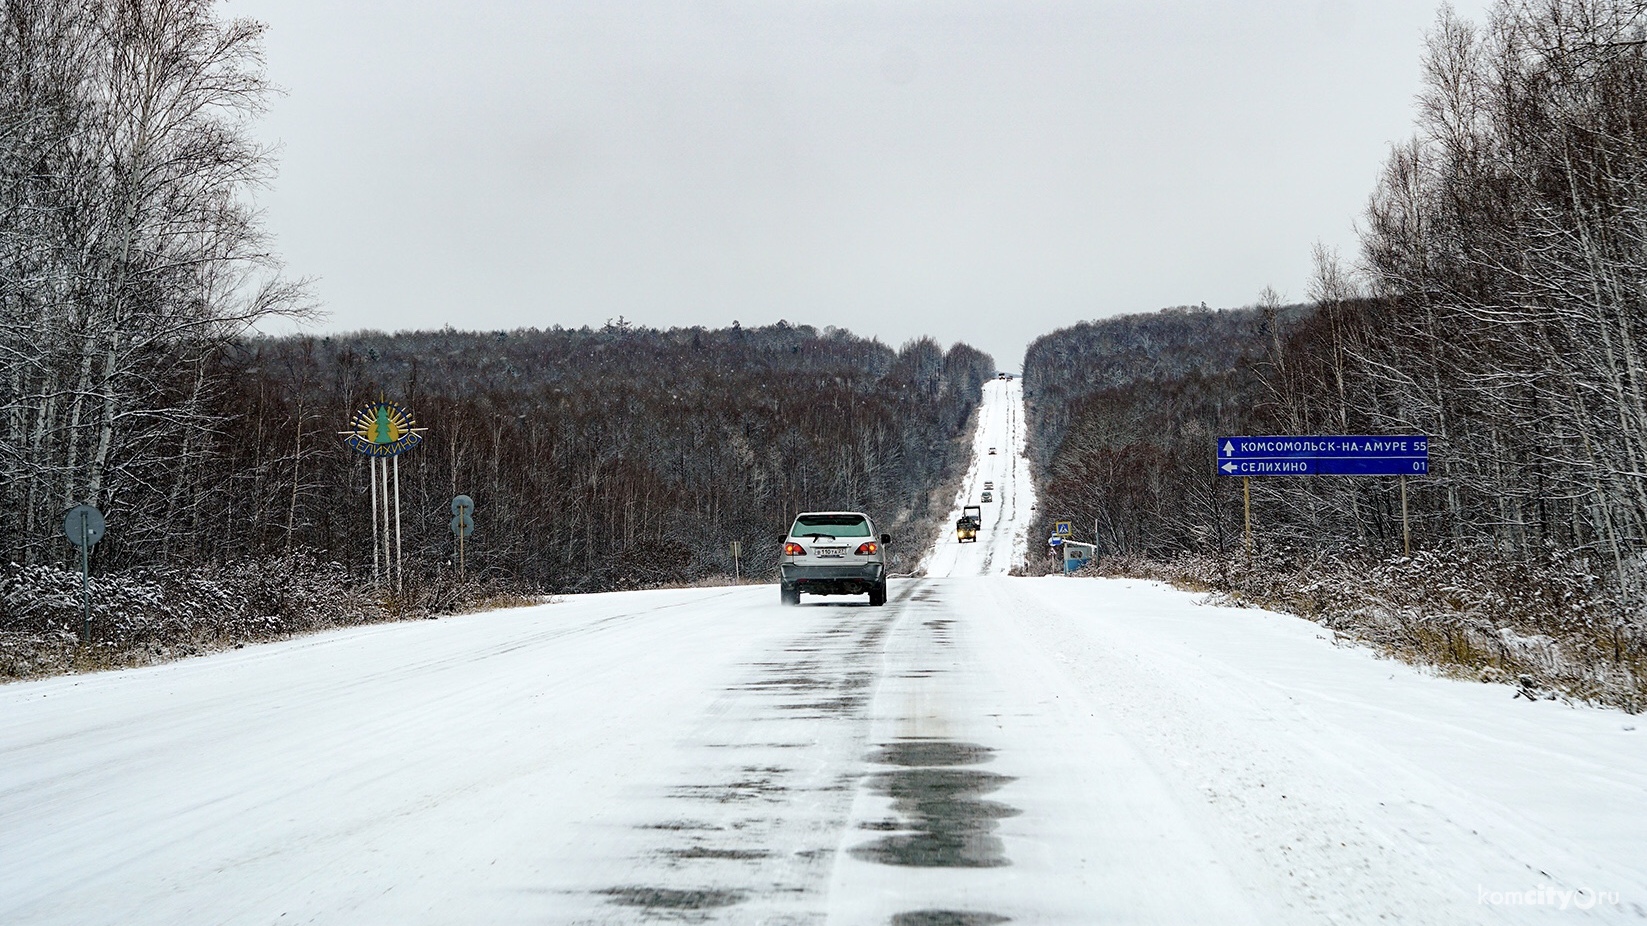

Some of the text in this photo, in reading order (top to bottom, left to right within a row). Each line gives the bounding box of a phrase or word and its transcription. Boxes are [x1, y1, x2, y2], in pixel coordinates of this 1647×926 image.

[348, 433, 418, 456] СЕЛИХИНО
[1240, 441, 1427, 452] КОМСОМОЛЬСК-НА-АМУРЕ 55
[1240, 461, 1426, 472] СЕЛИХИНО 01
